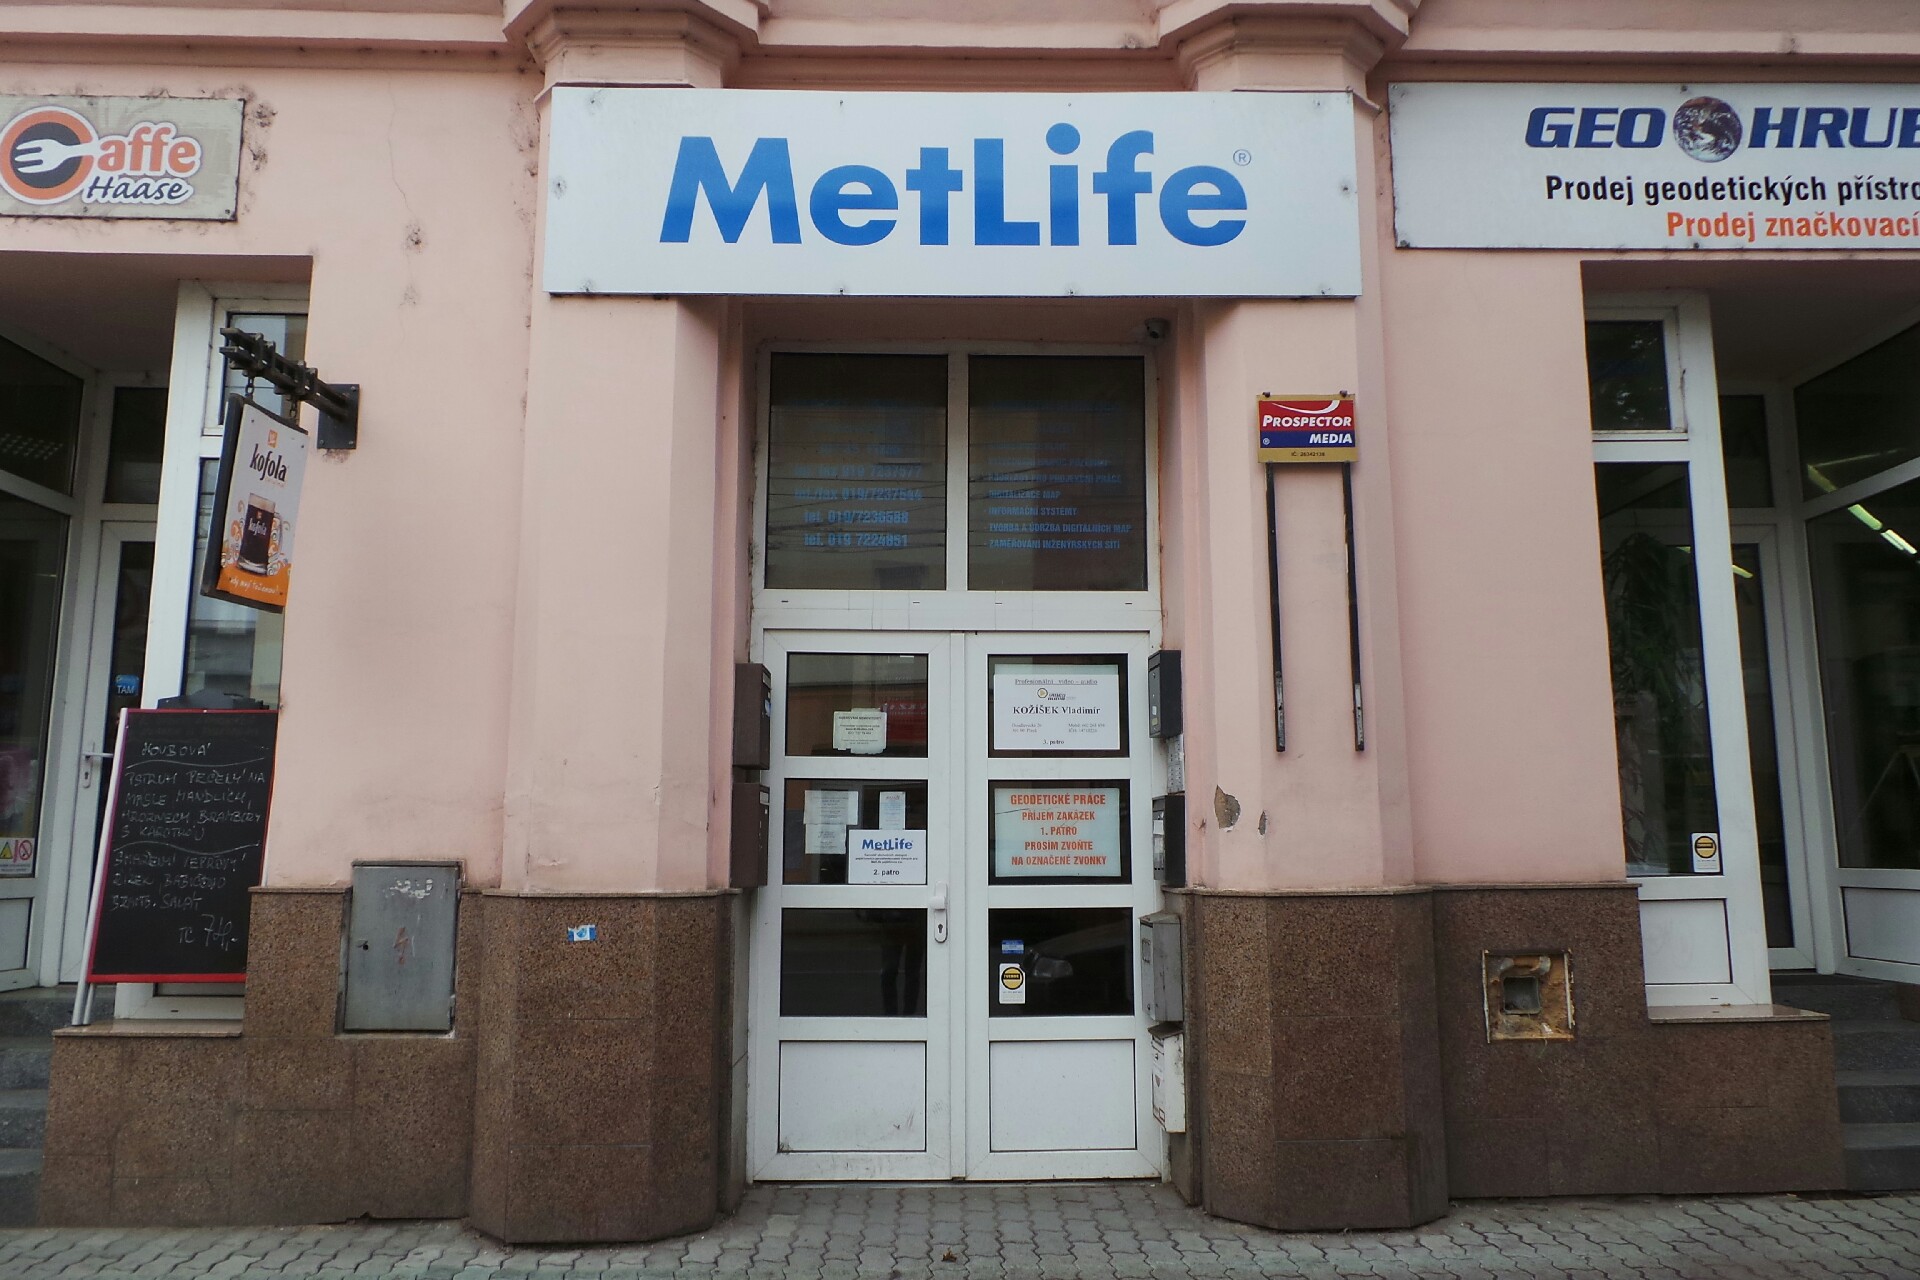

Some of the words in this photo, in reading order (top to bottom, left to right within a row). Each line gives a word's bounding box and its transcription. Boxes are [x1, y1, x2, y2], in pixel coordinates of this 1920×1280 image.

[1525, 107, 1666, 149] GEO
[87, 176, 188, 201] Haase
[1545, 175, 1634, 206] Prodej
[1645, 174, 1827, 206] geodetických
[1667, 211, 1756, 242] Prodej
[1262, 414, 1352, 428] PROSPECTOR
[1308, 433, 1353, 444] MEDIA
[249, 443, 287, 482] kofola
[117, 685, 135, 694] TAM
[1013, 704, 1059, 715] KOŽÍŠEK
[1061, 706, 1101, 715] Vladimír
[1010, 793, 1071, 805] GEODETICKÉ
[1073, 793, 1106, 805] PRÁCE
[1022, 809, 1054, 821] PŘÍJEM
[1056, 809, 1095, 821] ZAKÁZEK
[1040, 827, 1048, 836] 1.
[1050, 826, 1077, 836] PATRO
[861, 837, 913, 850] MetLife
[1024, 840, 1059, 851] PROSÍM
[1061, 840, 1094, 851] ZVOŇTE
[1011, 856, 1024, 866] NA
[1026, 854, 1071, 866] OZNAČENÉ
[1073, 855, 1107, 865] ZVONKY
[881, 869, 900, 877] patro
